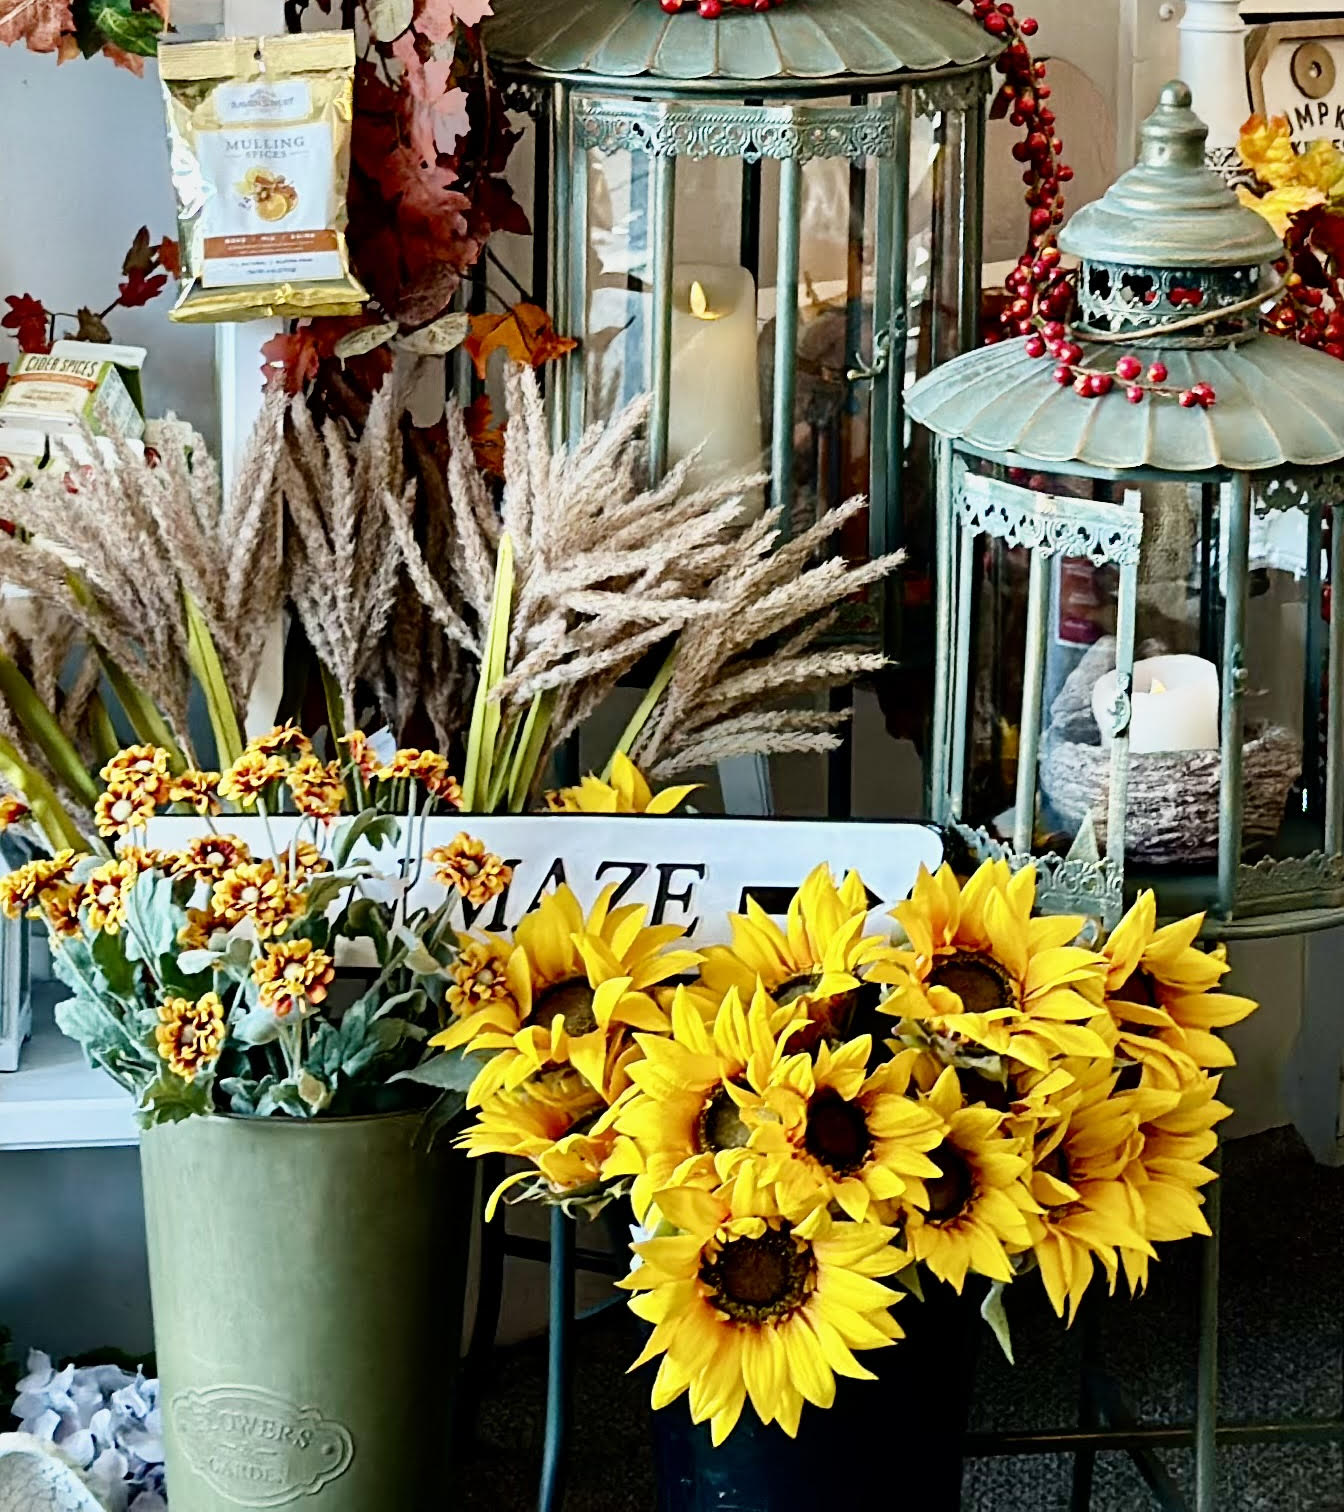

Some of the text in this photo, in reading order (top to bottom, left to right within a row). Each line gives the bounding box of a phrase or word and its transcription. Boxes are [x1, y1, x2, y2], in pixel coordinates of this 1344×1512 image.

[226, 135, 305, 152] MULLING
[245, 149, 287, 159] SPICES
[24, 355, 99, 378] CIDER SPICES
